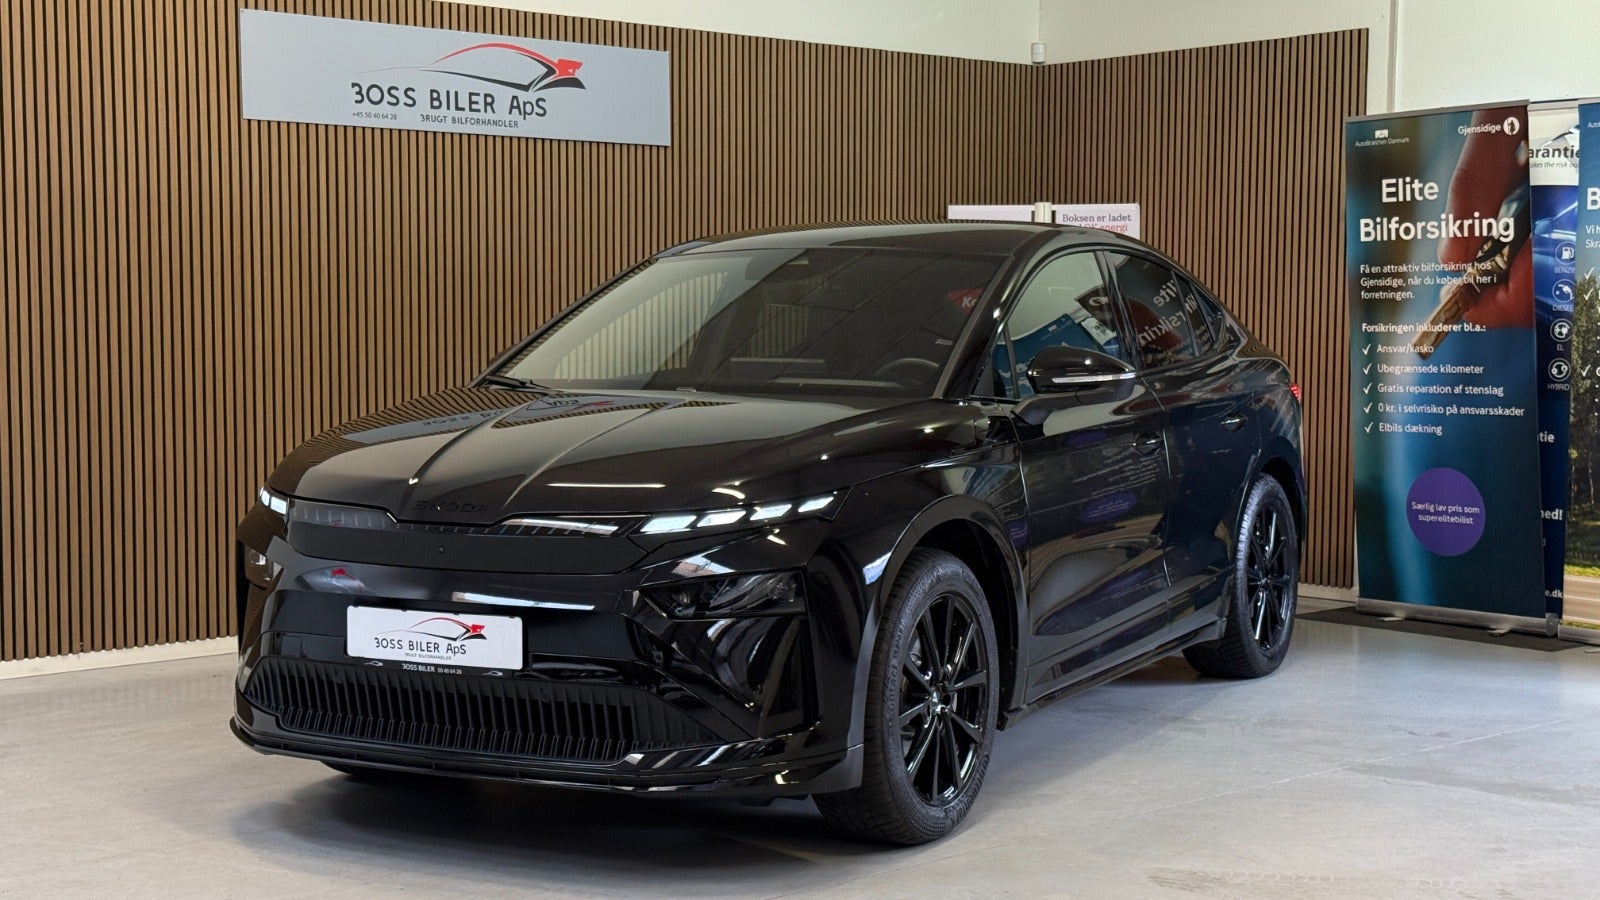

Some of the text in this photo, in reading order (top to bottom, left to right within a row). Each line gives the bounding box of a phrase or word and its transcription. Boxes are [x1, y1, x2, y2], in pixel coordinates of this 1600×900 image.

[429, 88, 496, 114] BILER
[508, 95, 548, 121] ApS
[452, 116, 519, 129] BILFORHANDLER
[1457, 123, 1502, 136] Gjensidige
[1544, 160, 1554, 168] the
[1556, 160, 1568, 168] risk
[1381, 176, 1439, 203] Elite
[1062, 213, 1094, 222] Boksen
[1108, 213, 1132, 222] ladet
[1359, 211, 1516, 243] Bilforsikring
[1585, 225, 1594, 234] Vi
[1360, 264, 1370, 274] Få
[1382, 263, 1420, 273] attraktiv
[1421, 262, 1472, 274] bilforsikring
[1474, 262, 1491, 270] hos
[1360, 277, 1406, 288] Gjensidige,
[1407, 277, 1422, 286] når
[1423, 276, 1434, 285] du
[1435, 276, 1462, 285] køber
[1463, 275, 1475, 284] bil
[1476, 275, 1491, 284] her
[1361, 290, 1415, 301] forretningen.
[1361, 323, 1486, 334] Forsikringen inkluderer bl.a.:
[1377, 343, 1434, 353] Ansvar/kasko
[1377, 363, 1484, 375] Ubegrænsede kilometer
[1378, 383, 1504, 397] Gratis reparation af stenslag
[1385, 403, 1397, 413] kr.
[1404, 404, 1444, 414] selvrisiko
[1446, 403, 1458, 416] på
[1459, 407, 1525, 417] ansvarsskader
[1379, 422, 1442, 436] Elbils dækning
[1538, 431, 1555, 443] tie
[1411, 501, 1480, 514] Særlig lav pris som
[1418, 514, 1474, 525] superelitebilist
[408, 641, 440, 653] BILER
[445, 643, 467, 656] ApS
[418, 664, 436, 673] BILER
